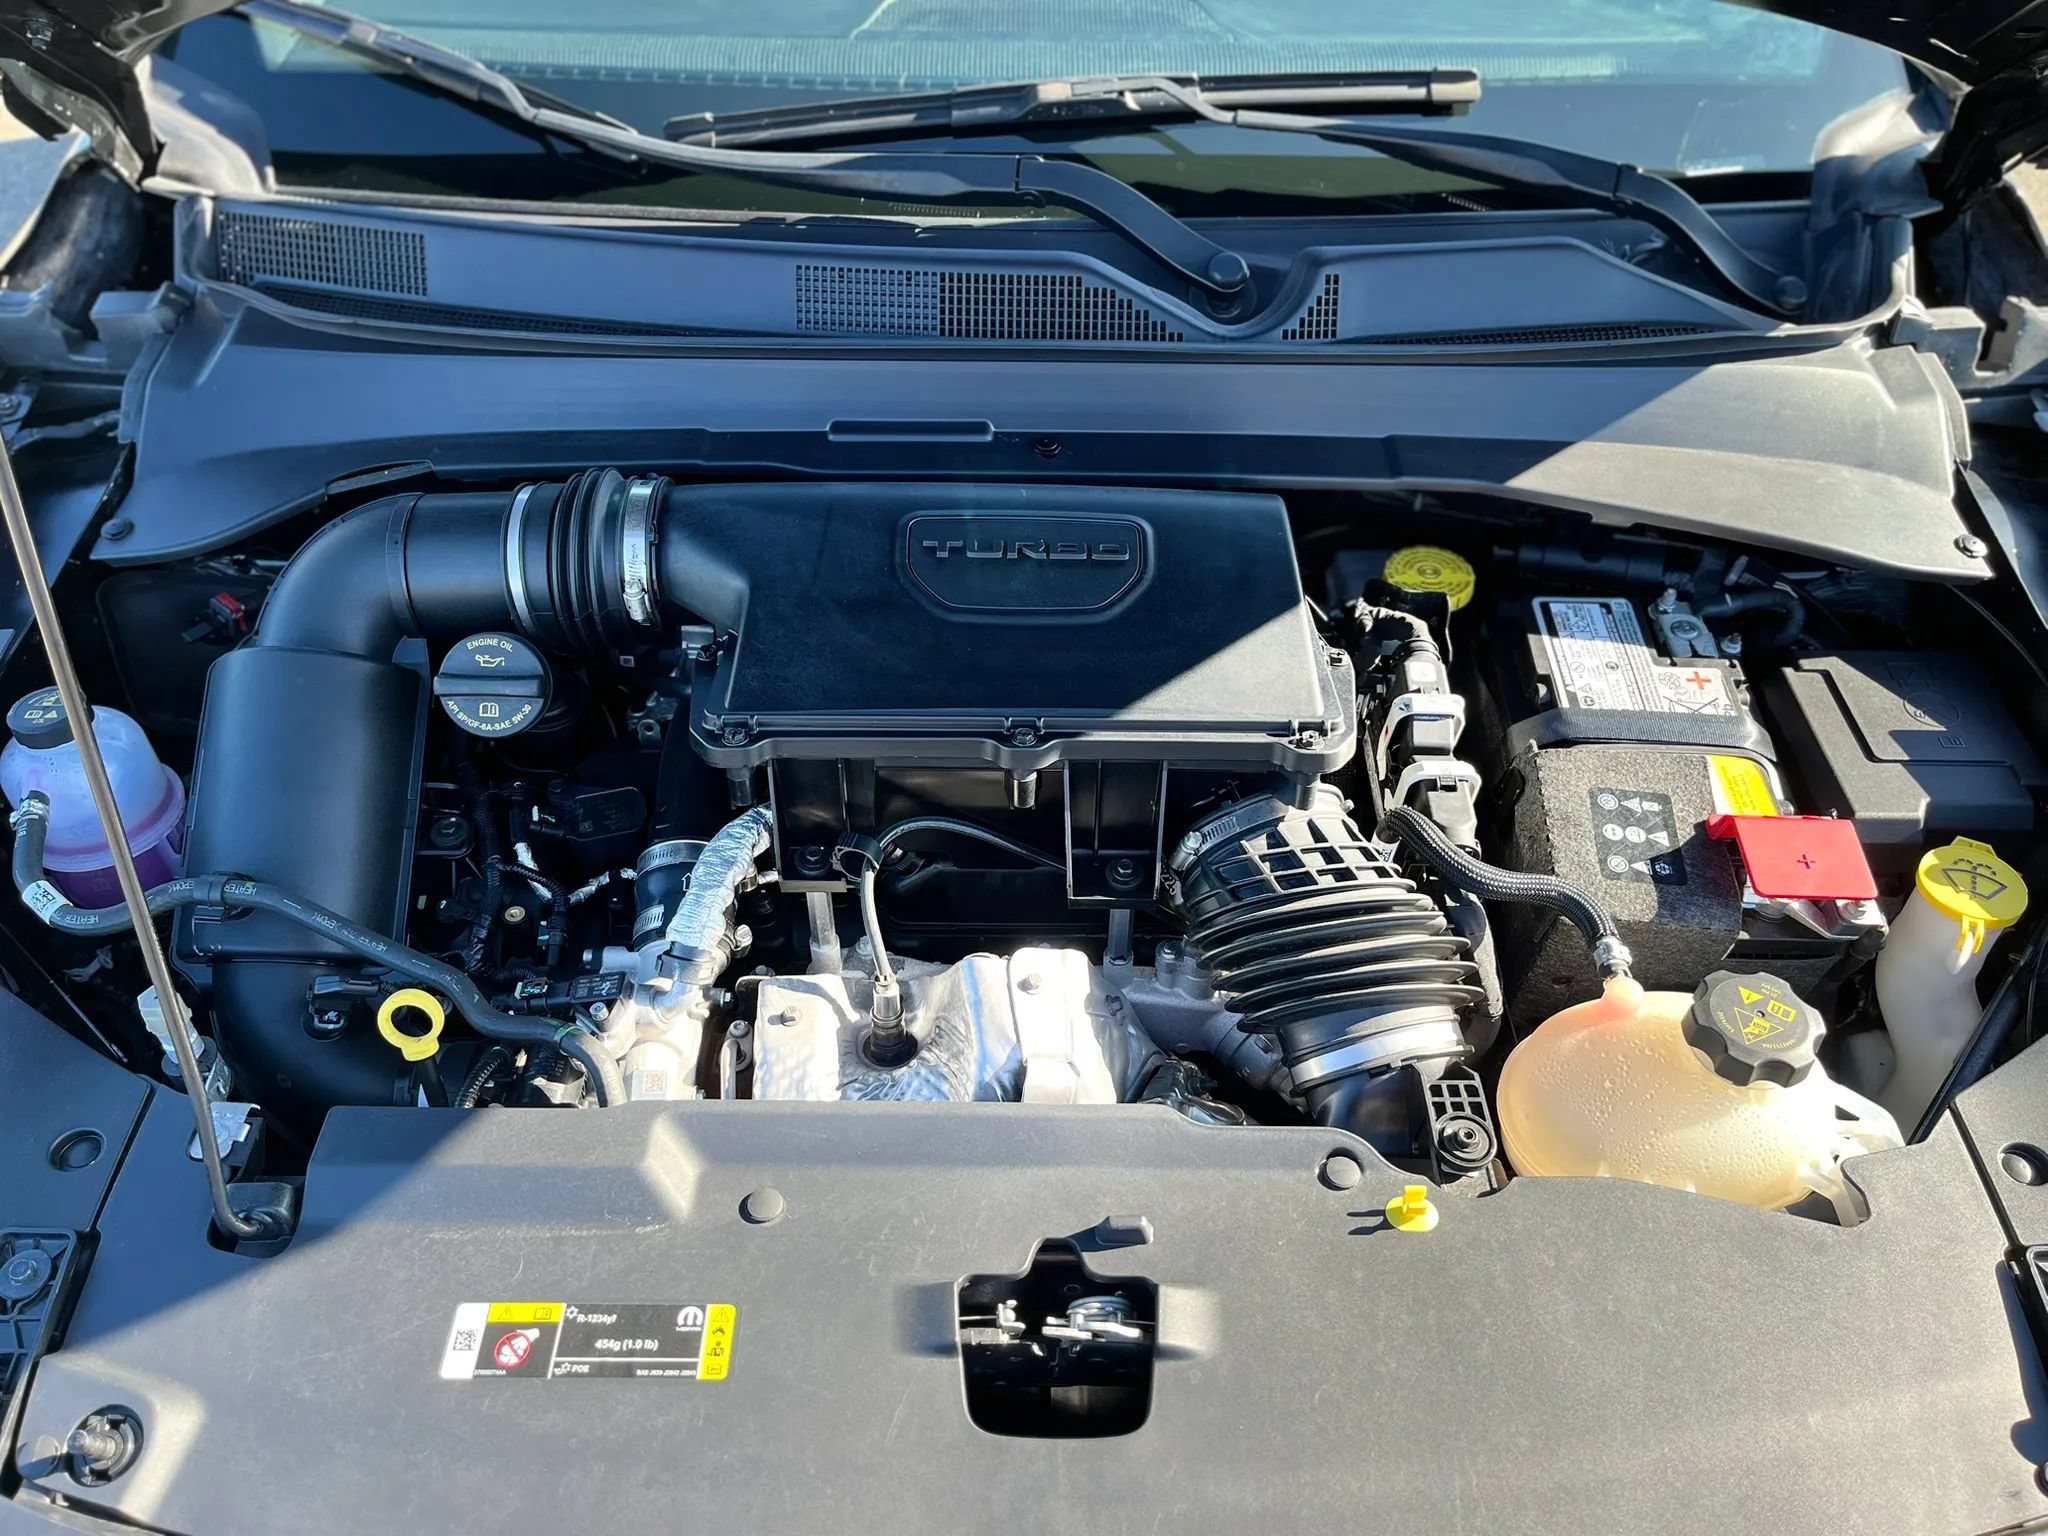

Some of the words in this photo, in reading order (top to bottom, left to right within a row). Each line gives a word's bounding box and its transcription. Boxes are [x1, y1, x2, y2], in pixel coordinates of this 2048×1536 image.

[921, 538, 1130, 561] TURBO
[466, 638, 499, 650] ENGINE
[499, 639, 514, 653] OIL
[446, 700, 459, 714] API
[511, 703, 532, 725] 5W-30
[224, 882, 258, 896] HEATER
[64, 913, 99, 925] HEATER
[594, 1338, 621, 1351] 454g
[622, 1339, 642, 1351] (1.0
[643, 1339, 659, 1351] lb)
